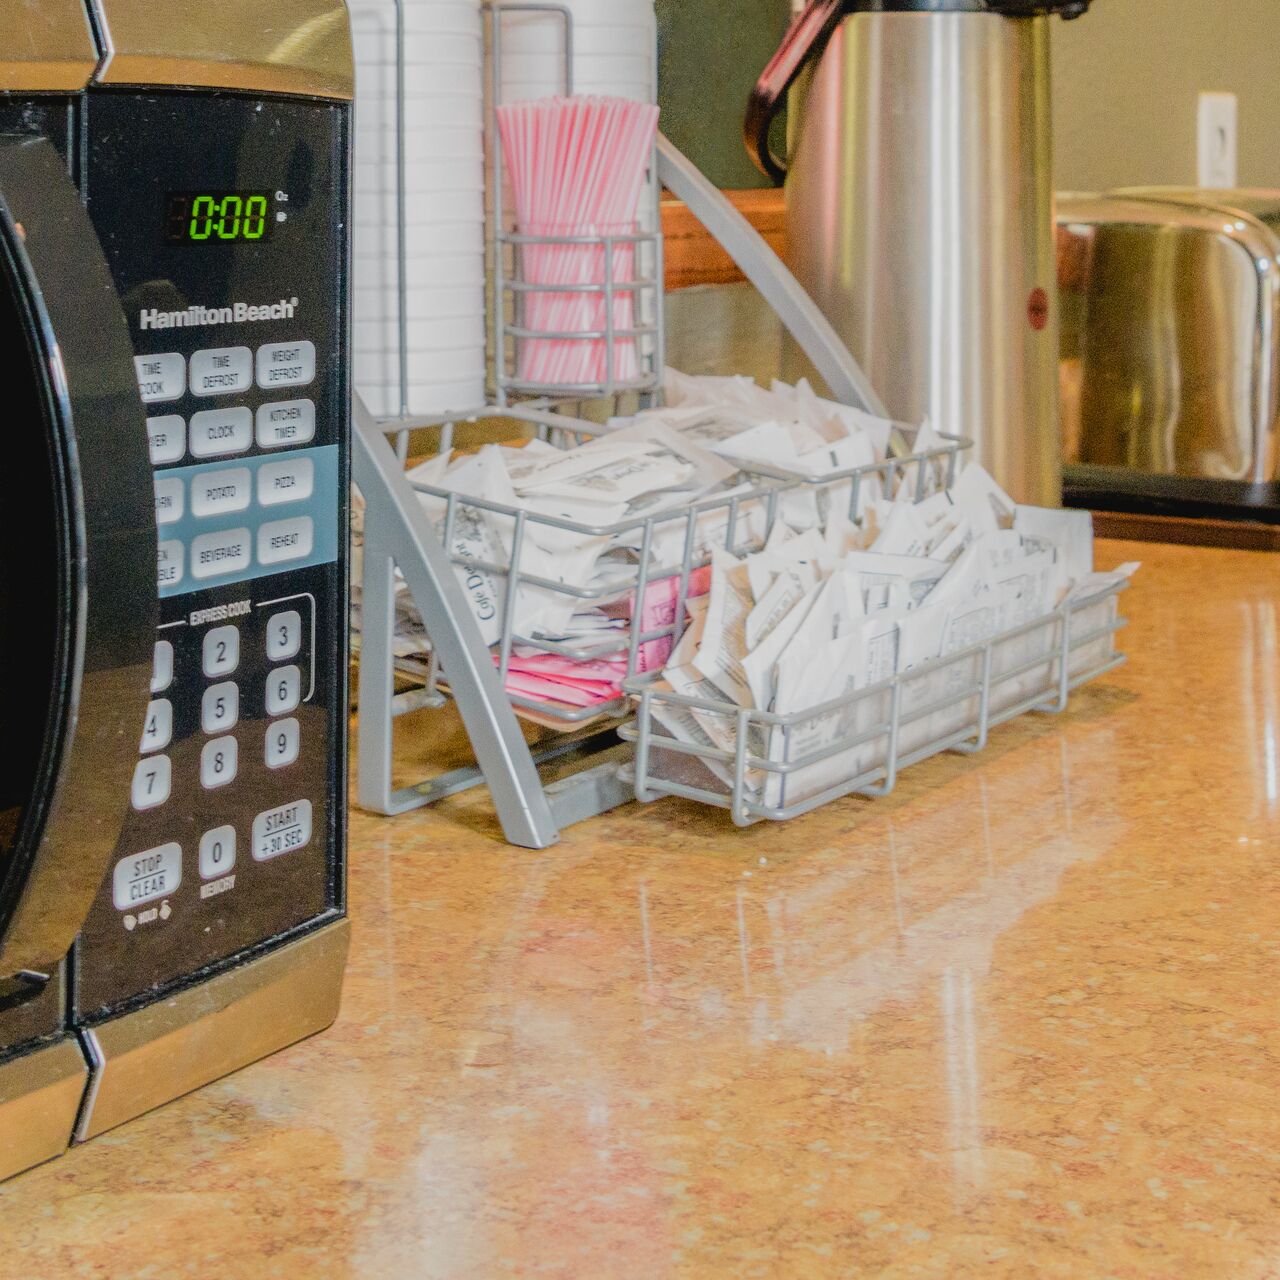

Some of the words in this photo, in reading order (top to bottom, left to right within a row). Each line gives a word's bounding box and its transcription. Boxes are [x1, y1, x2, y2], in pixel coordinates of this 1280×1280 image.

[189, 196, 267, 240] 0:00
[140, 305, 233, 330] Hamilton
[212, 355, 230, 368] TIME
[271, 348, 300, 362] WEIGHT
[142, 362, 161, 375] TIME
[269, 366, 302, 381] DEFROST
[202, 372, 239, 388] DEFROST
[270, 407, 301, 422] KITCHEN
[207, 424, 234, 439] CLOCK
[274, 426, 296, 440] TIMER
[275, 475, 296, 489] PIZZA
[206, 485, 236, 501] POTATO
[271, 533, 299, 549] REHEAT
[200, 544, 242, 564] BEVERAGE
[190, 604, 228, 626] EXPRESS
[278, 625, 288, 646] 3
[216, 641, 226, 663] 2
[278, 680, 288, 701] 6
[214, 697, 225, 718] 5
[145, 715, 156, 737] 4
[277, 732, 287, 755] 9
[214, 752, 224, 773] 8
[146, 771, 157, 795] 7
[265, 807, 298, 831] START
[285, 829, 302, 847] SEC
[212, 842, 222, 863] 0
[134, 853, 163, 877] STOP
[131, 875, 165, 900] CLEAR
